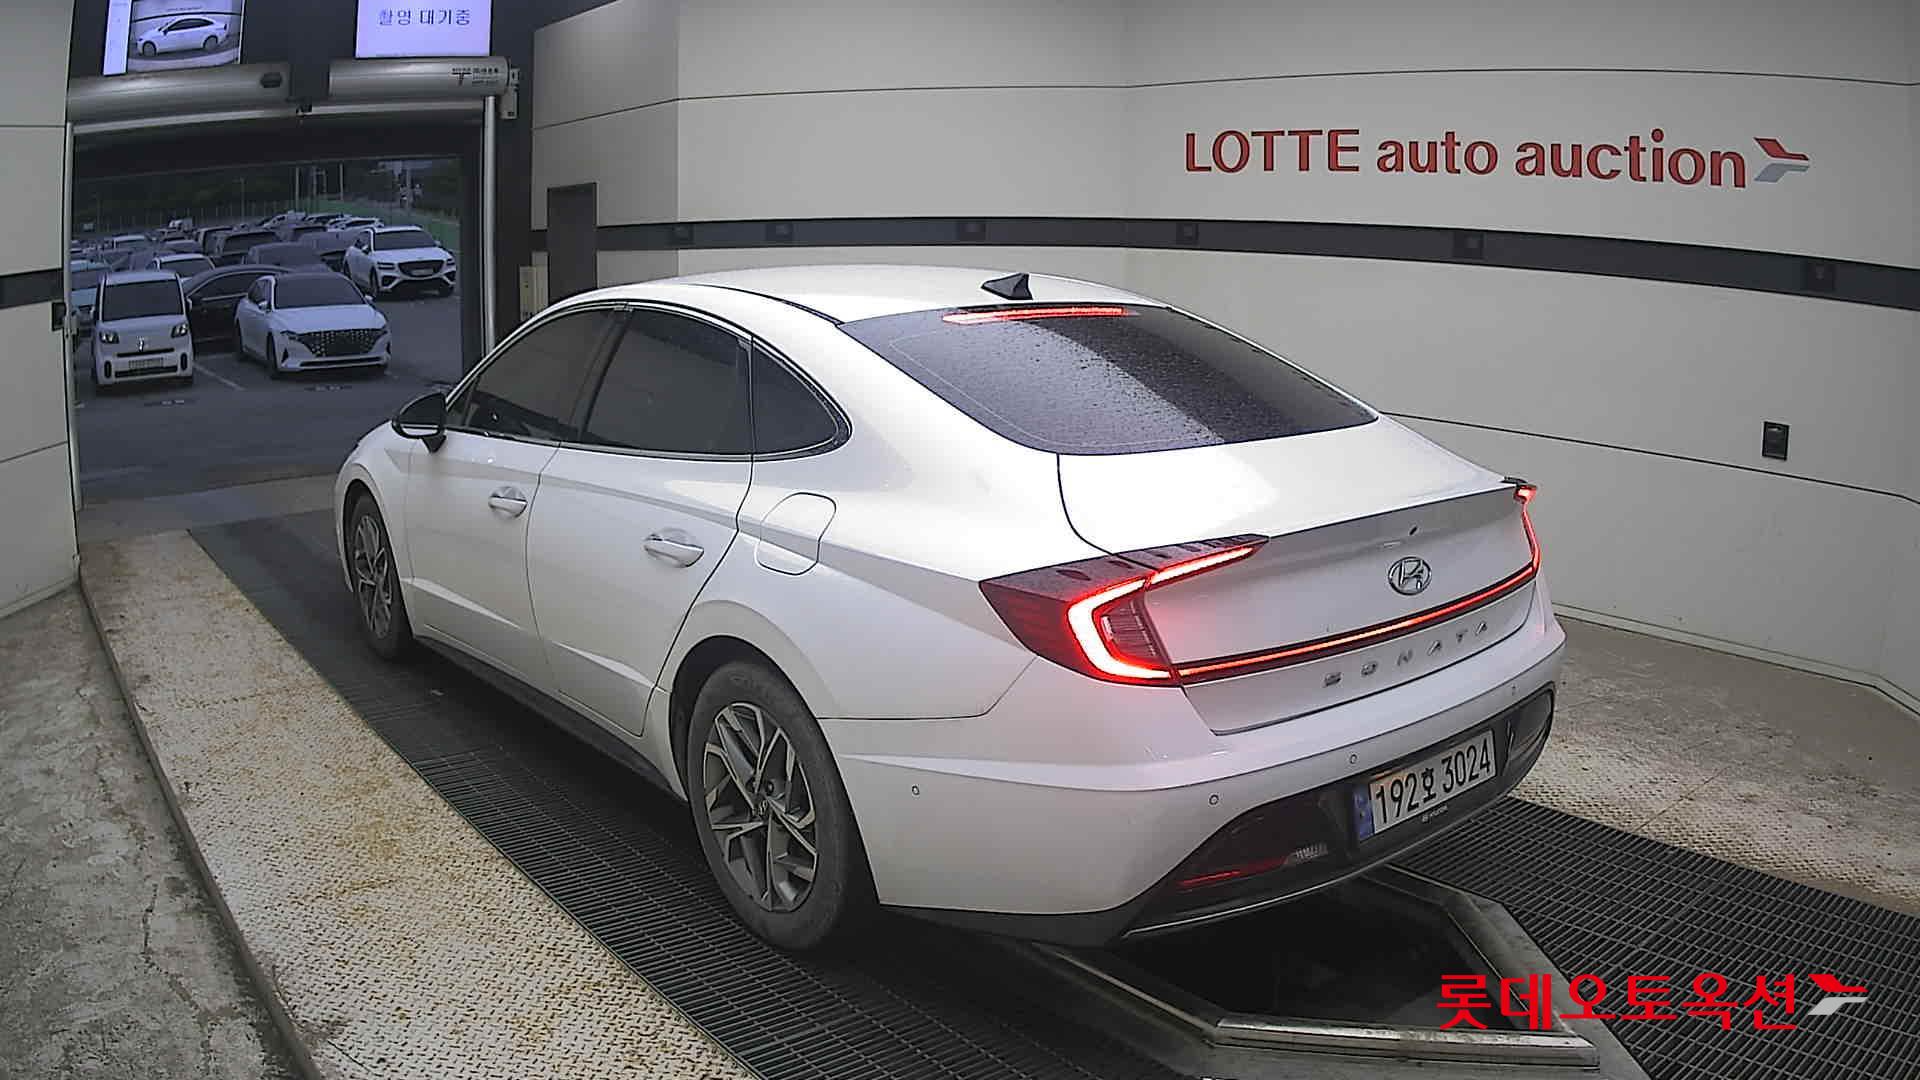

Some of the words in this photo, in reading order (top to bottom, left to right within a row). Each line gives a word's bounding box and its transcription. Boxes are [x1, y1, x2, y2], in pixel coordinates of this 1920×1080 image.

[419, 8, 471, 26] 대기중
[1186, 129, 1361, 173] LOTTE
[1377, 131, 1499, 175] auto
[1515, 128, 1747, 189] auction
